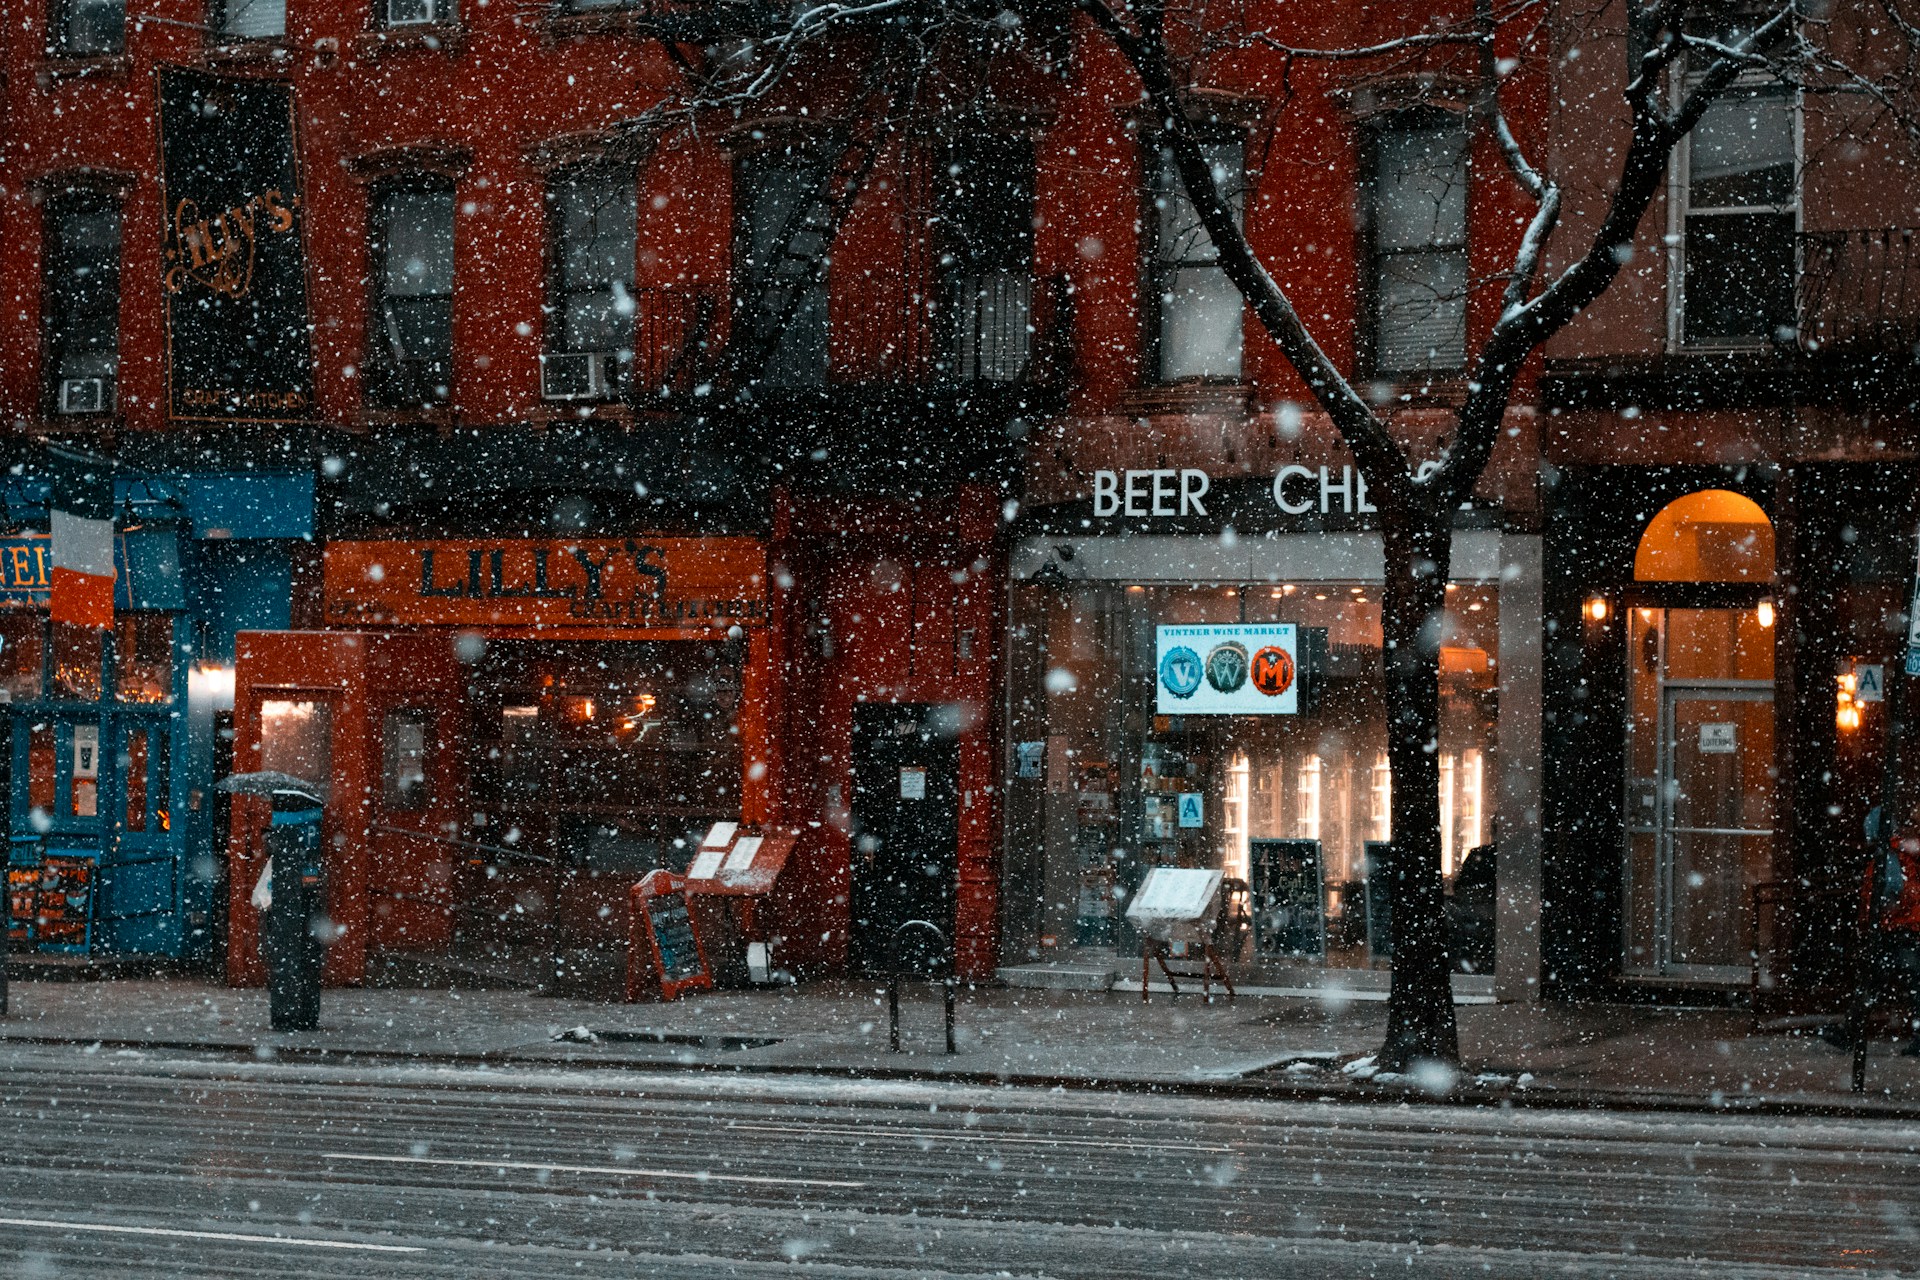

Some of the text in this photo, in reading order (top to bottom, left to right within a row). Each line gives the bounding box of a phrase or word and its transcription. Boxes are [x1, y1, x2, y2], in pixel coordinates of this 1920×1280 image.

[1094, 469, 1209, 516] BEER
[421, 540, 667, 599] LILLY'S
[1164, 628, 1210, 636] VINTNER
[1244, 627, 1290, 635] MARKET
[1171, 657, 1287, 688] V W M
[1860, 669, 1878, 691] A
[1702, 738, 1733, 747] LOITERING
[1183, 798, 1199, 818] A
[308, 825, 316, 845] P
